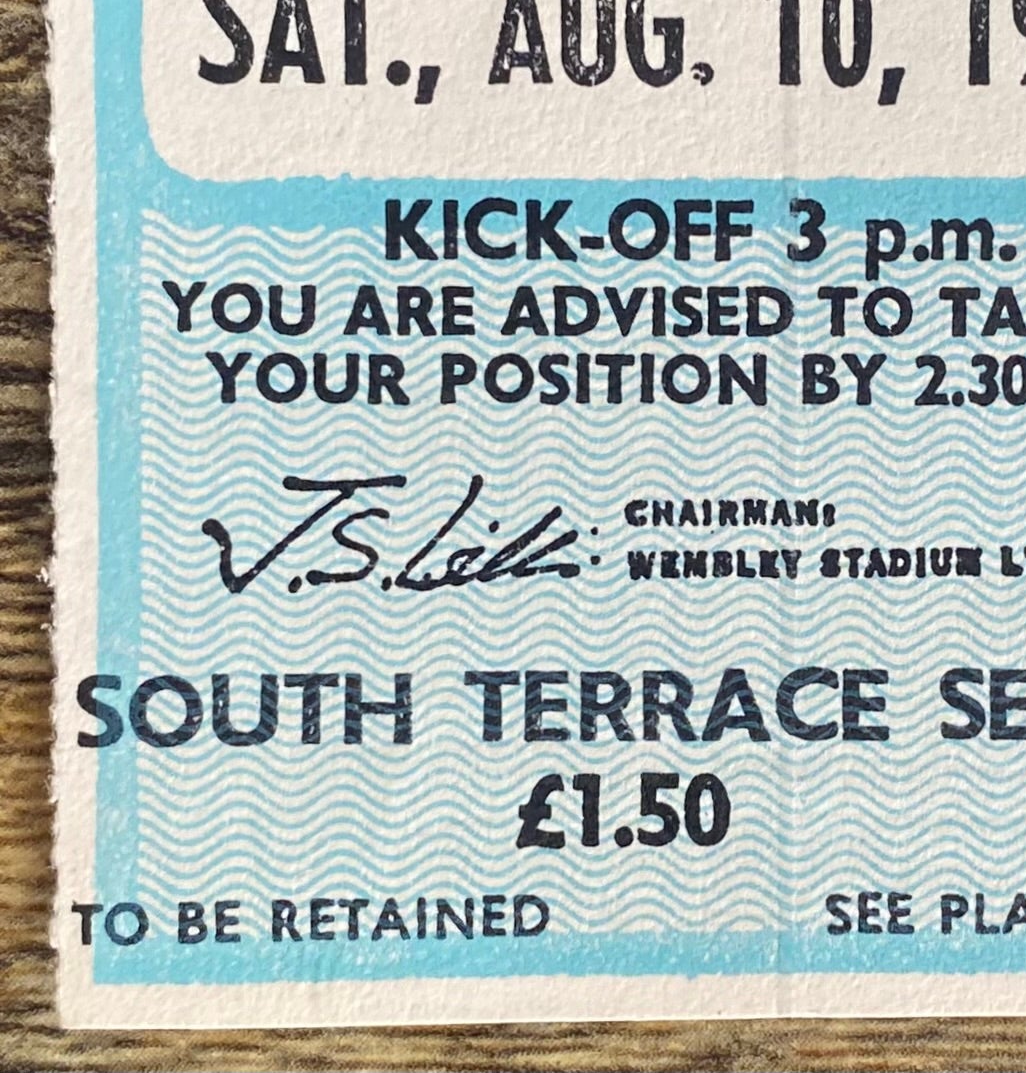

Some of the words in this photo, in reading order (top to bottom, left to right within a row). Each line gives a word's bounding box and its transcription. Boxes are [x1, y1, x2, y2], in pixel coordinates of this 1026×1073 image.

[385, 198, 754, 262] KICK-OFF
[787, 198, 826, 262] 3
[866, 218, 1016, 281] p.m.
[162, 281, 316, 336] YOU
[344, 285, 475, 336] ARE
[501, 286, 794, 337] ADVISED
[818, 284, 913, 337] TO
[206, 352, 409, 405] YOUR
[441, 353, 767, 406] POSITION
[802, 354, 886, 405] BY
[628, 549, 801, 580] WEMBLEY
[820, 547, 982, 578] STADIUM
[77, 674, 412, 748] SOUTH
[465, 667, 889, 742] TERRACE
[516, 772, 730, 849] £1.50
[72, 903, 148, 945] TO
[178, 901, 240, 943] BE
[272, 895, 549, 941] RETAINED
[826, 892, 914, 934] SEE
